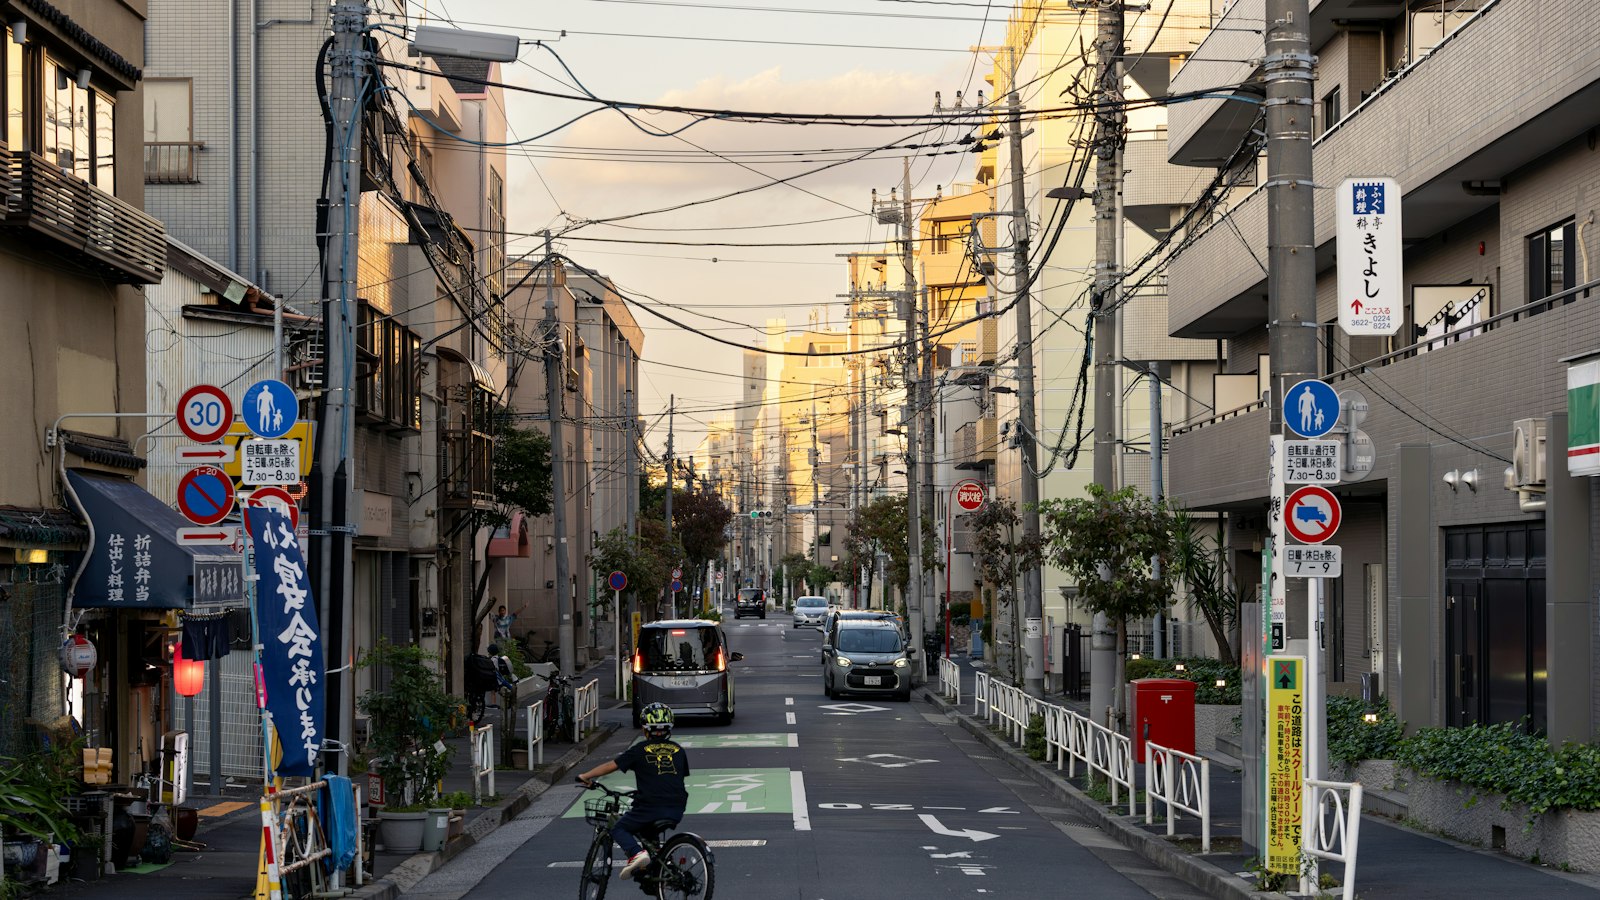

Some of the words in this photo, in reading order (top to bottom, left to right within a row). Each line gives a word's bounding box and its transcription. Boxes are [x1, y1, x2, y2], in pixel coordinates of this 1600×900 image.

[1355, 188, 1368, 213] 料理
[1362, 232, 1380, 298] きよし
[1364, 307, 1391, 315] ここ入る
[189, 401, 221, 427] 30
[246, 444, 295, 456] 自転車を除く
[1287, 445, 1337, 456] 自転車は通行可
[193, 467, 218, 477] 7-20
[959, 491, 982, 503] 消火栓
[1287, 549, 1337, 561] 日曜・休日を除く
[107, 533, 125, 602] 仕出し料理
[133, 533, 152, 602] 折詰弁当
[1291, 694, 1302, 851] この道路はスクールゾーンです。
